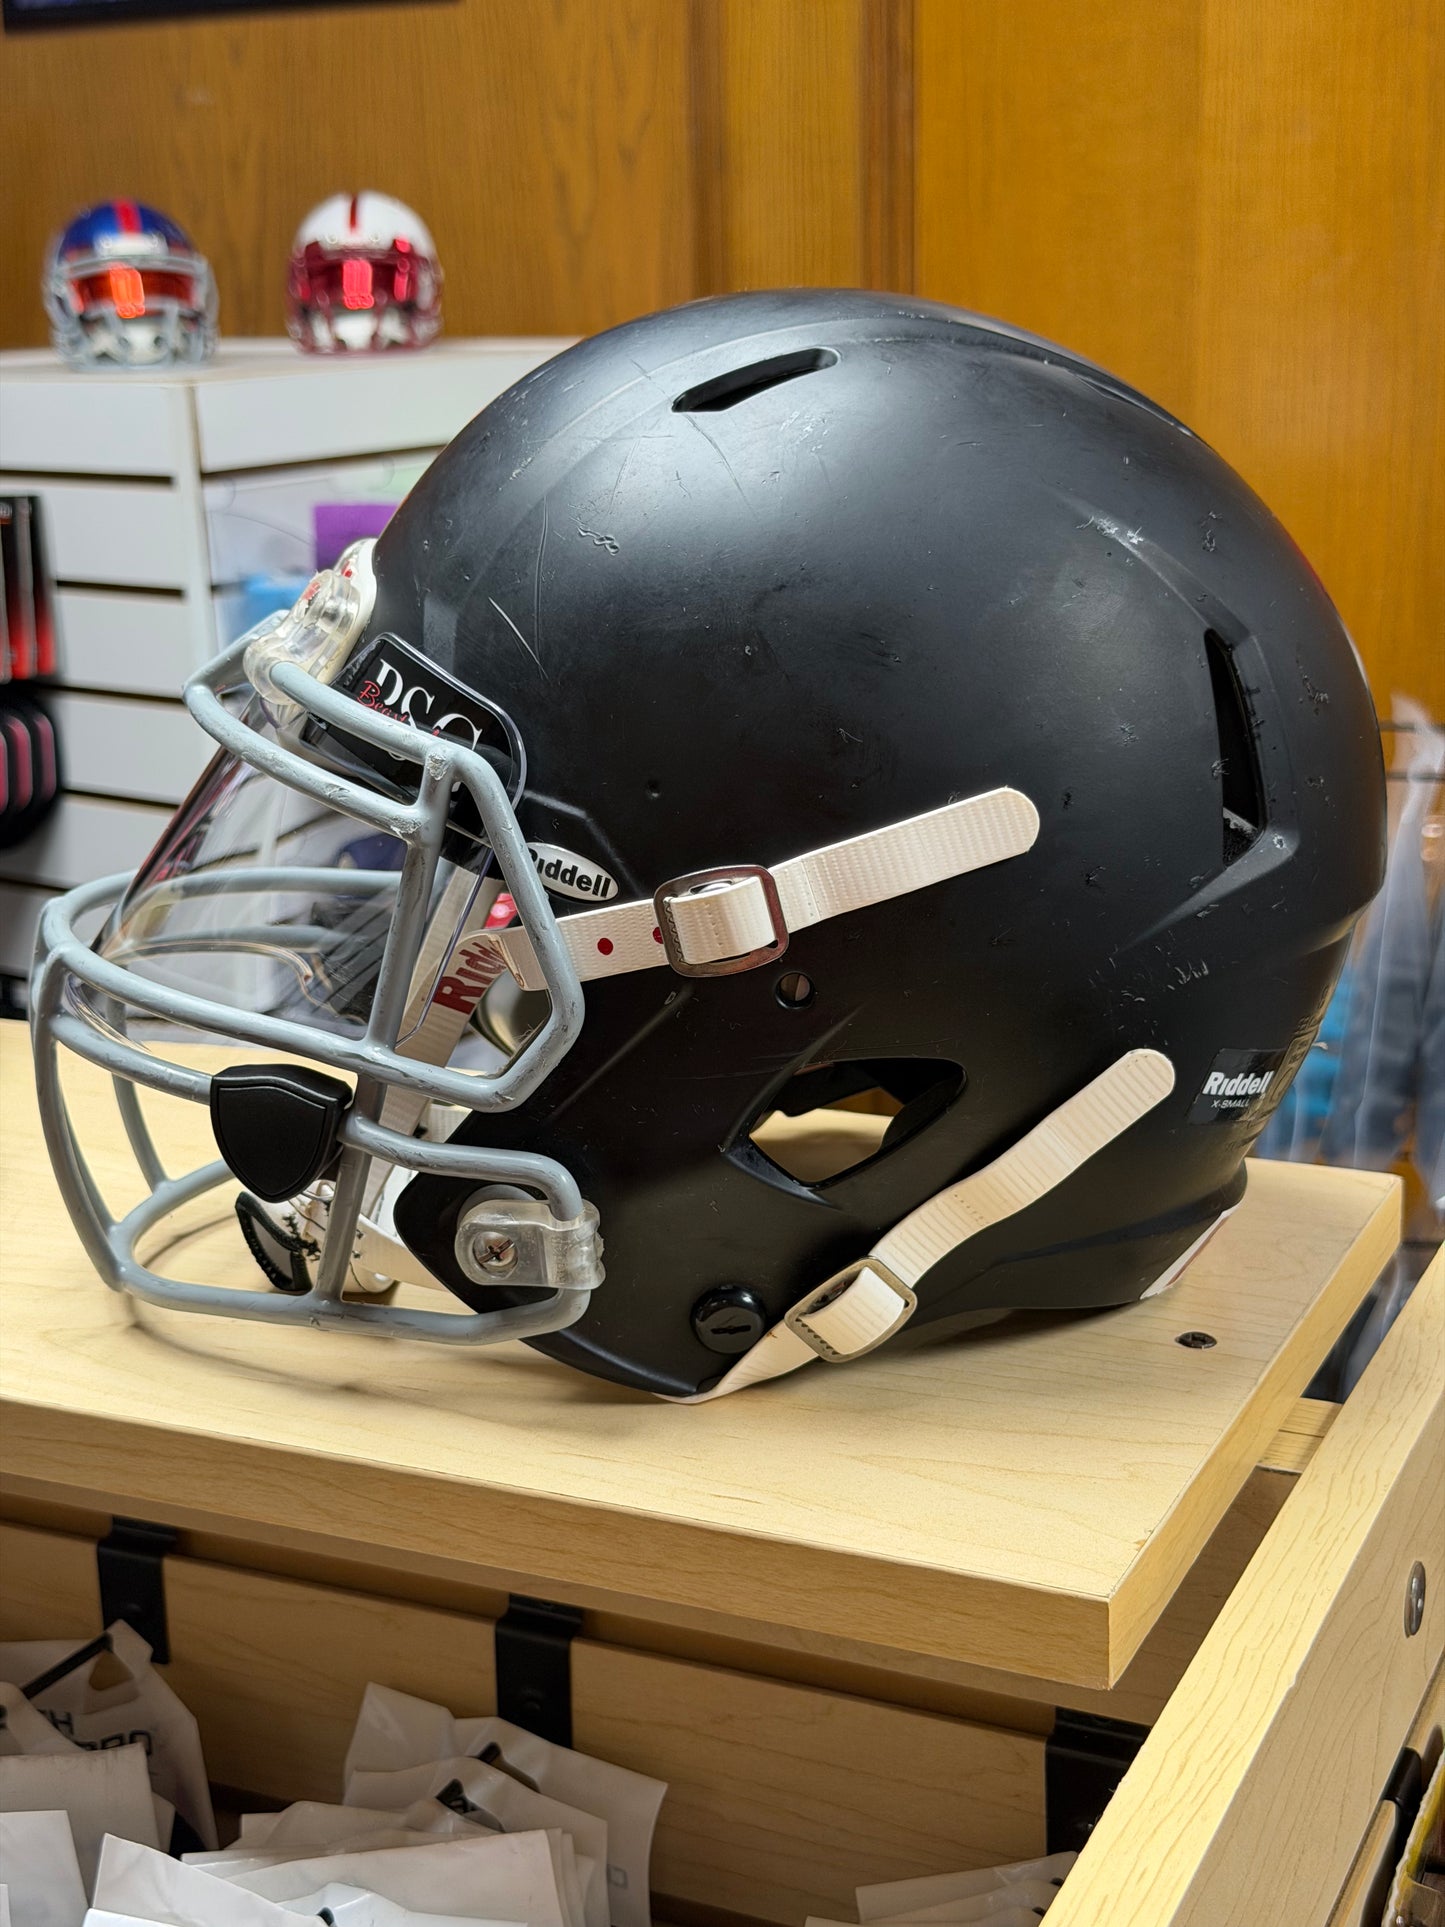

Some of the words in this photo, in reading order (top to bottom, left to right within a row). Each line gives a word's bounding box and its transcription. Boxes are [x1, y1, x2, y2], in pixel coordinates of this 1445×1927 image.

[432, 941, 507, 1015] Ridd
[1202, 1071, 1275, 1096] Riddell
[1211, 1099, 1251, 1109] X-SMALL
